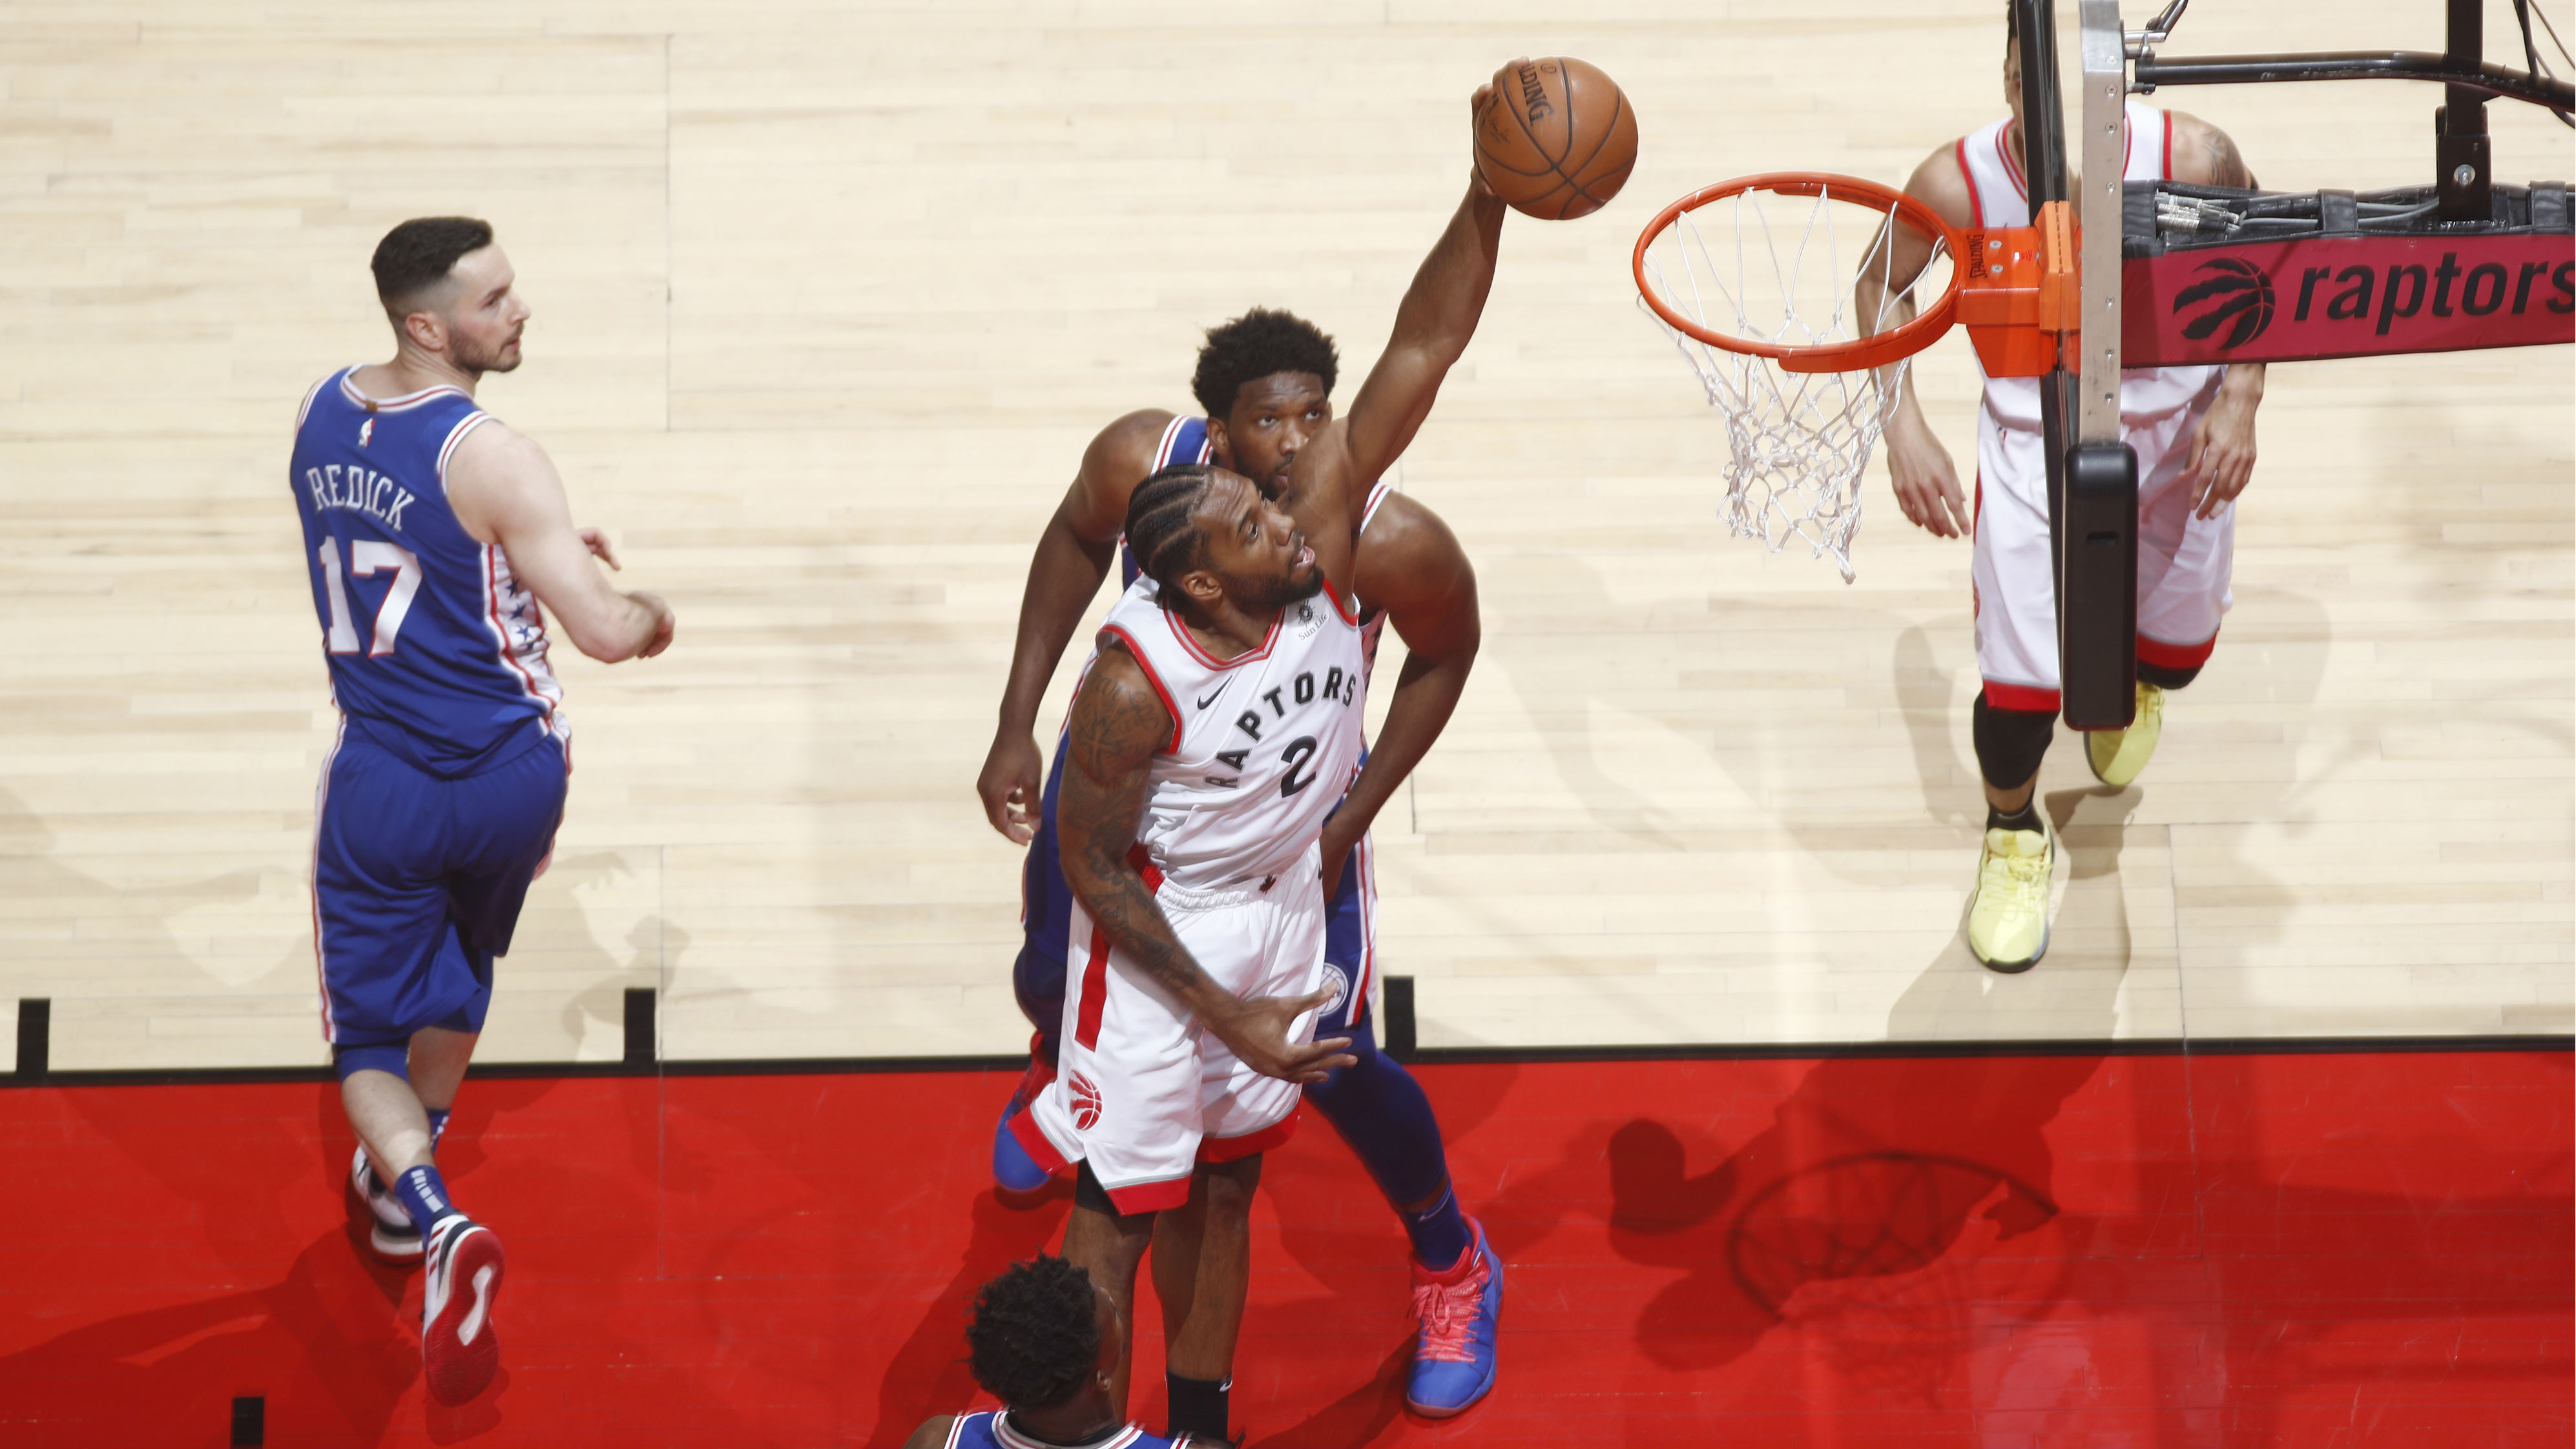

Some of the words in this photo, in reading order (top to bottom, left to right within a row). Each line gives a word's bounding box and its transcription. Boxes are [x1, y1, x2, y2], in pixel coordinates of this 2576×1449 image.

[1518, 63, 1555, 127] LDING
[1966, 234, 1988, 278] SPALDING
[2294, 252, 2576, 336] raptors
[306, 464, 415, 531] REDICK
[318, 535, 423, 659] 17
[1298, 626, 1316, 641] Sun
[1315, 613, 1328, 630] Life
[1204, 664, 1357, 788] RAPTORS
[1280, 735, 1318, 798] 2
